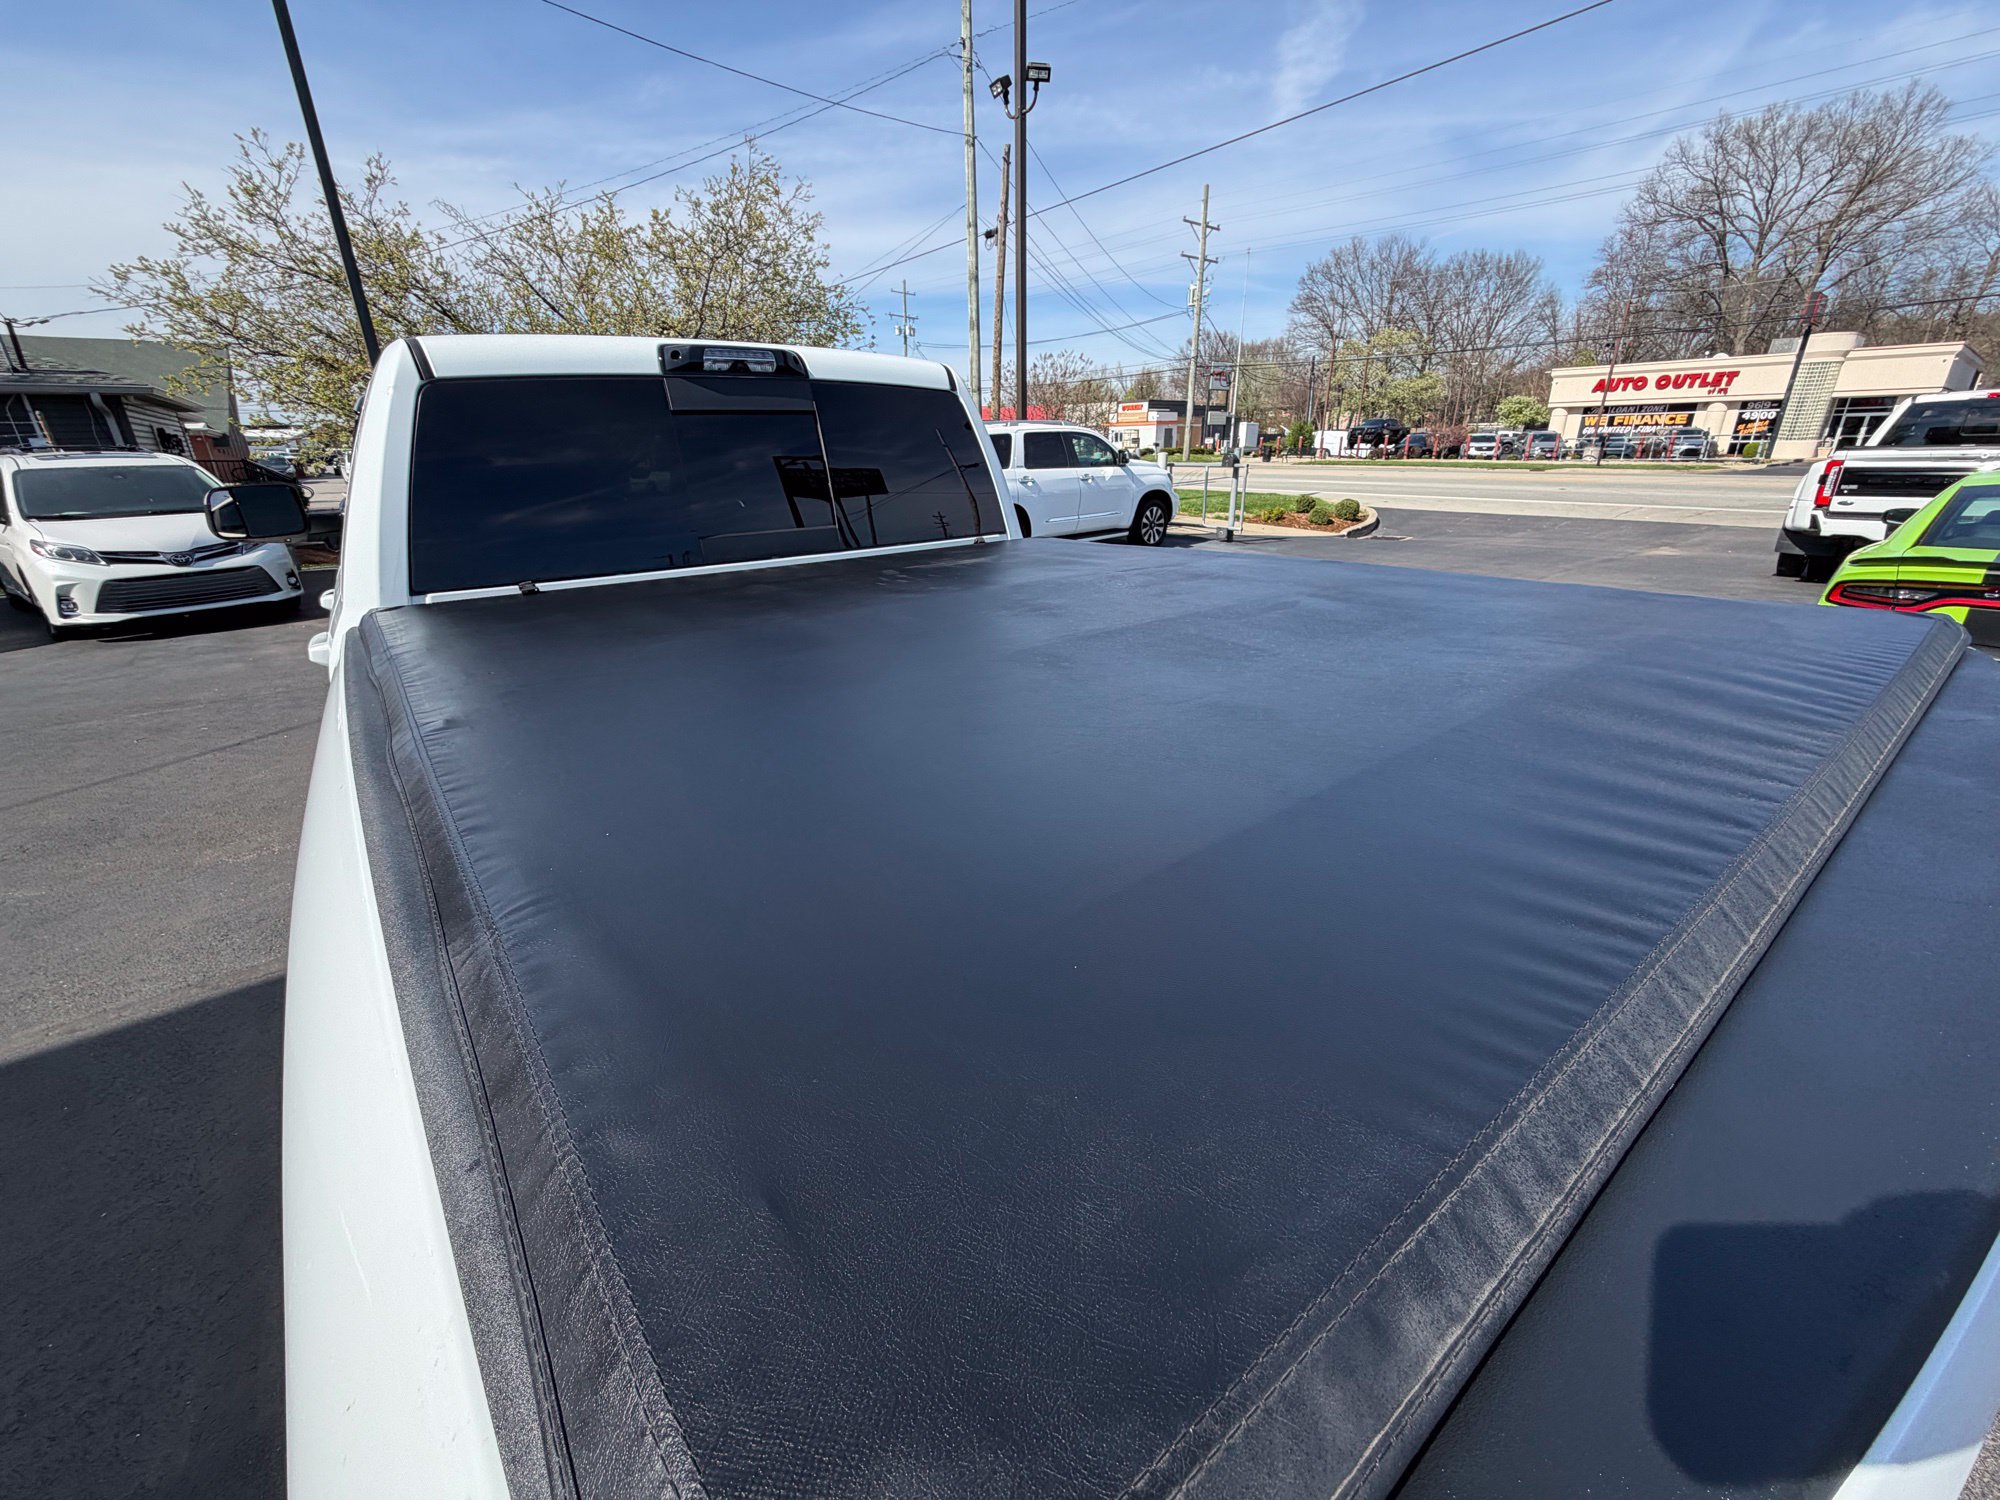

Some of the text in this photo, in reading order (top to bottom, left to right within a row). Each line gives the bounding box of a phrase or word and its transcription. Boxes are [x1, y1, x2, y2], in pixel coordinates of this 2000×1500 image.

[1591, 371, 1740, 393] AUTO OUTLET
[1584, 414, 1688, 426] WE FINANCE
[1741, 411, 1776, 420] 4900
